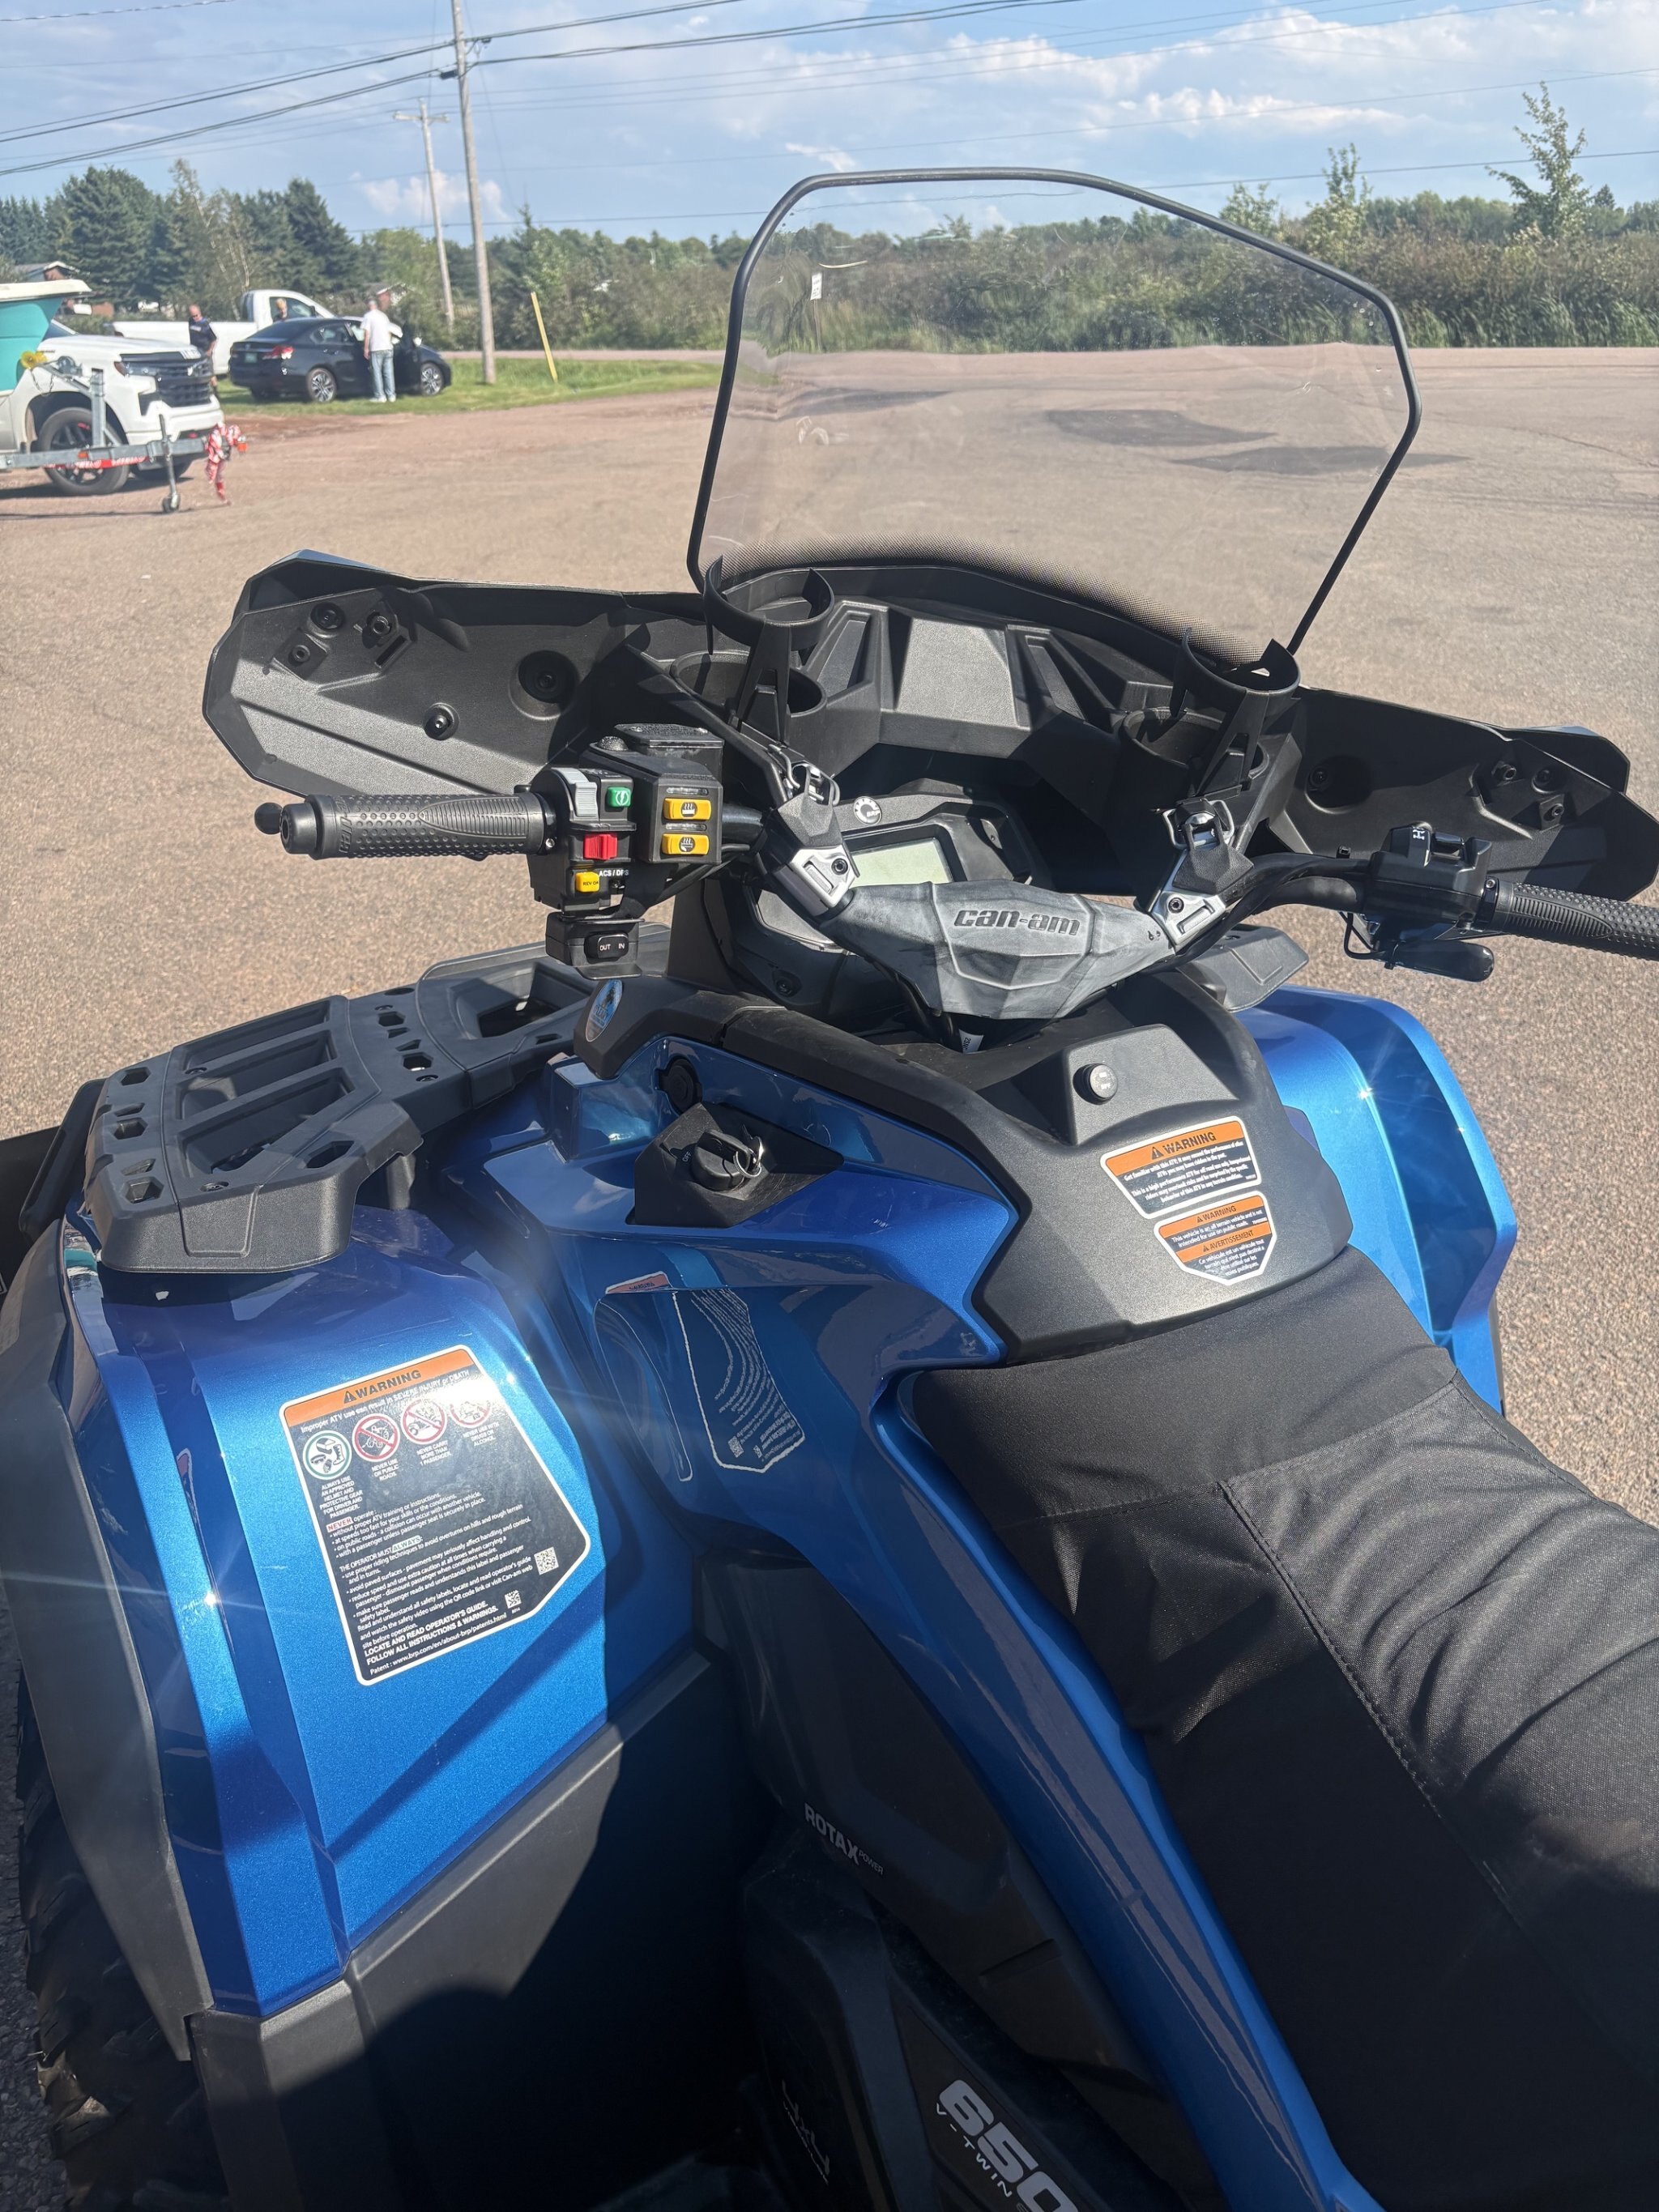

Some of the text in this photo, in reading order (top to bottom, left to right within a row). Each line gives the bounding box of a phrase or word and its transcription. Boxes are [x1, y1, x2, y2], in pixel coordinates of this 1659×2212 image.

[953, 910, 1081, 936] can-am
[682, 1151, 692, 1162] OFF
[1162, 1132, 1217, 1154] WARNING
[1183, 1229, 1200, 1239] vehicle
[1203, 1204, 1236, 1221] WARNING
[1209, 1230, 1254, 1250] AVERTISSEMENT
[354, 1369, 422, 1400] WARNING
[327, 1517, 352, 1531] NEVER
[332, 1491, 441, 1537] without proper ATV training instructions.
[338, 1495, 486, 1558] with passenger unless passenger seat securely place.
[340, 1492, 457, 1543] speeds too fast for your skills the conditions.
[343, 1490, 482, 1549] public roads collision can occur with another vehicle.
[339, 1563, 350, 1572] THE
[349, 1553, 377, 1568] OPERATOR
[377, 1547, 392, 1558] MUST
[344, 1502, 523, 1579] use proper riding techniques avoid overturns hills and rough terrain
[348, 1515, 531, 1593] avoid paved surfaces pavement may seriously affect handling and control.
[348, 1566, 382, 1584] and turns.
[351, 1589, 370, 1602] reduce
[369, 1583, 387, 1596] speed
[386, 1579, 397, 1588] and
[397, 1575, 407, 1583] use
[406, 1569, 421, 1579] extra
[420, 1561, 441, 1574] caution
[452, 1550, 467, 1561] times
[467, 1544, 482, 1555] when
[481, 1536, 503, 1550] carrying
[356, 1554, 531, 1632] Read and understand all safety labels, locate and read operator's guide
[359, 1563, 533, 1640] and watch the safety video using the code link visit Can-am web
[361, 1622, 418, 1649] site before operation.
[364, 1600, 488, 1657] LOCATE AND READ OPERATOR'S GUIDE.
[366, 1604, 499, 1665] FOLLOW ALL INSTRUCTIONS WARNINGS.
[391, 1612, 507, 1667] www.brp.com/en/about-brp/patents.html
[804, 1801, 884, 1876] ROTAX POWER
[939, 2079, 1079, 2212] 650
